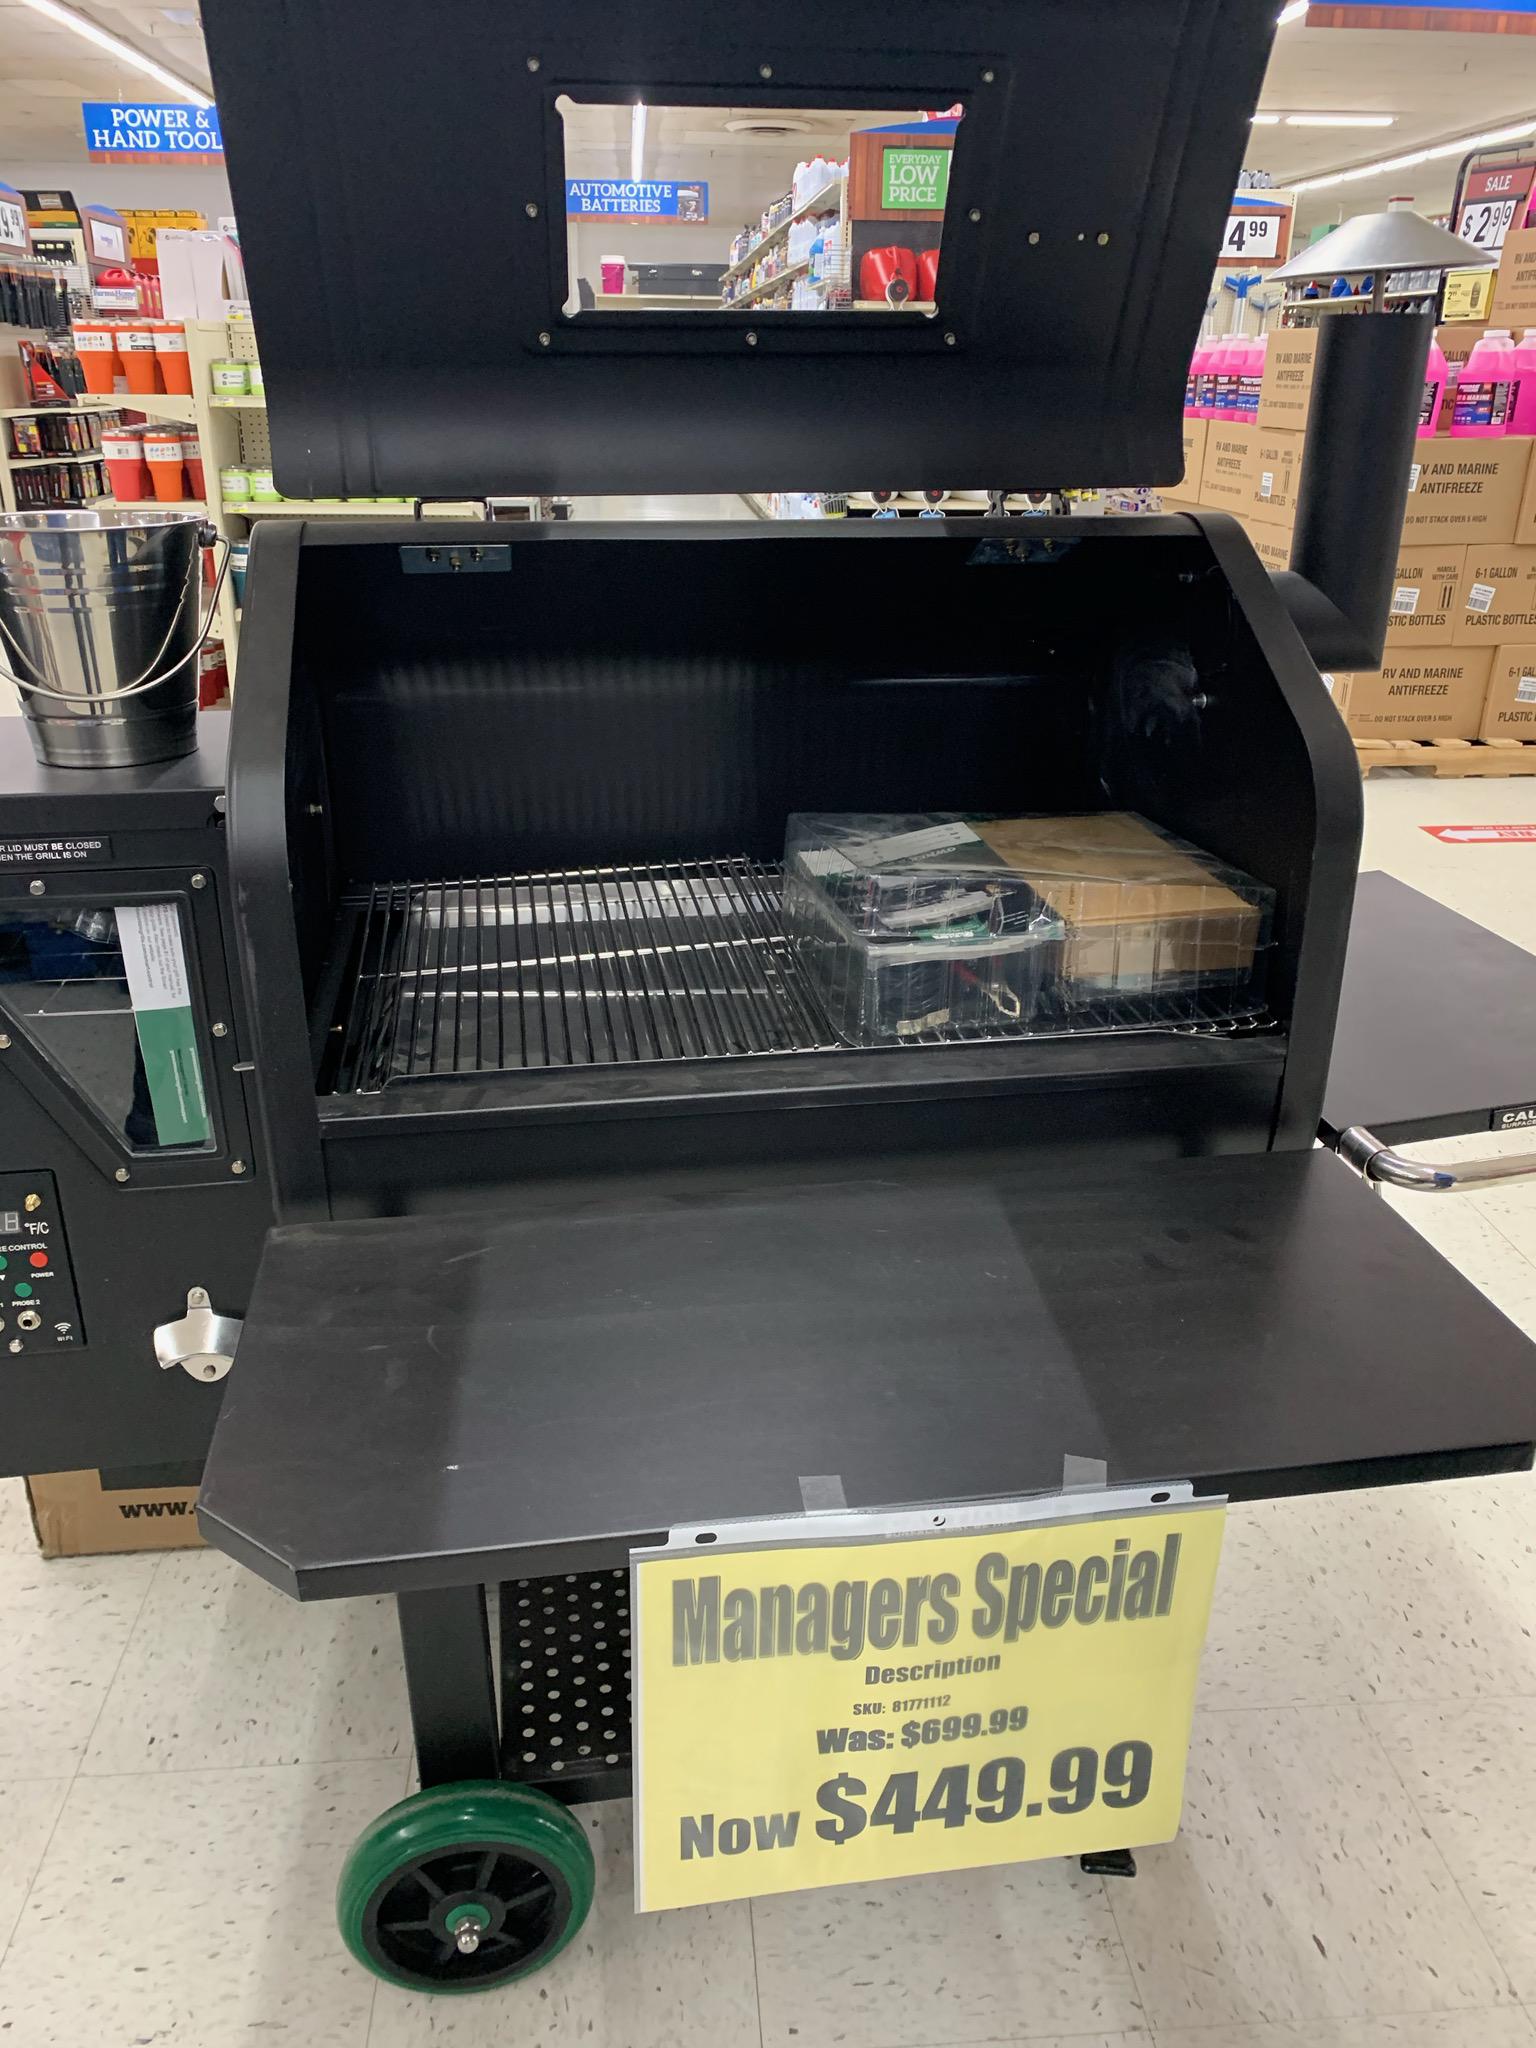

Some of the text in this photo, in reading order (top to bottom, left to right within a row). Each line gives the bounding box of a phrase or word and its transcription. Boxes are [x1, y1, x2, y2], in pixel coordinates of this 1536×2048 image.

[111, 108, 210, 129] POWER &
[93, 129, 160, 148] HAND
[889, 154, 942, 164] EVERYDAY
[889, 165, 940, 185] LOW
[1485, 175, 1513, 192] SALE
[569, 183, 672, 198] AUTOMOTIVE
[889, 186, 937, 202] PRICE
[581, 198, 661, 213] BATTERIES
[1431, 464, 1454, 475] AND
[1457, 463, 1499, 475] MARINE
[1420, 482, 1484, 494] ANTIFREEZE
[1489, 567, 1518, 578] GALLON
[1408, 614, 1447, 625] BOTTLES
[1465, 614, 1501, 626] PLASTIC
[1382, 668, 1464, 679] RV AND MARINE
[1388, 684, 1449, 696] ANTIFREEZE
[1498, 711, 1533, 722] PLASTIC
[8, 844, 22, 852] LID
[24, 843, 48, 852] MUST
[65, 841, 102, 850] CLOSED
[15, 853, 33, 861] THE
[35, 852, 61, 860] GRILL
[63, 851, 72, 859] IS
[8, 1242, 48, 1252] CONTROL
[672, 1533, 1182, 1666] Managers Special
[865, 1654, 1001, 1685] Description
[853, 1702, 886, 1716] SKU:
[816, 1705, 1029, 1755] Was: $699.99
[680, 1740, 1153, 1860] Now $449.99
